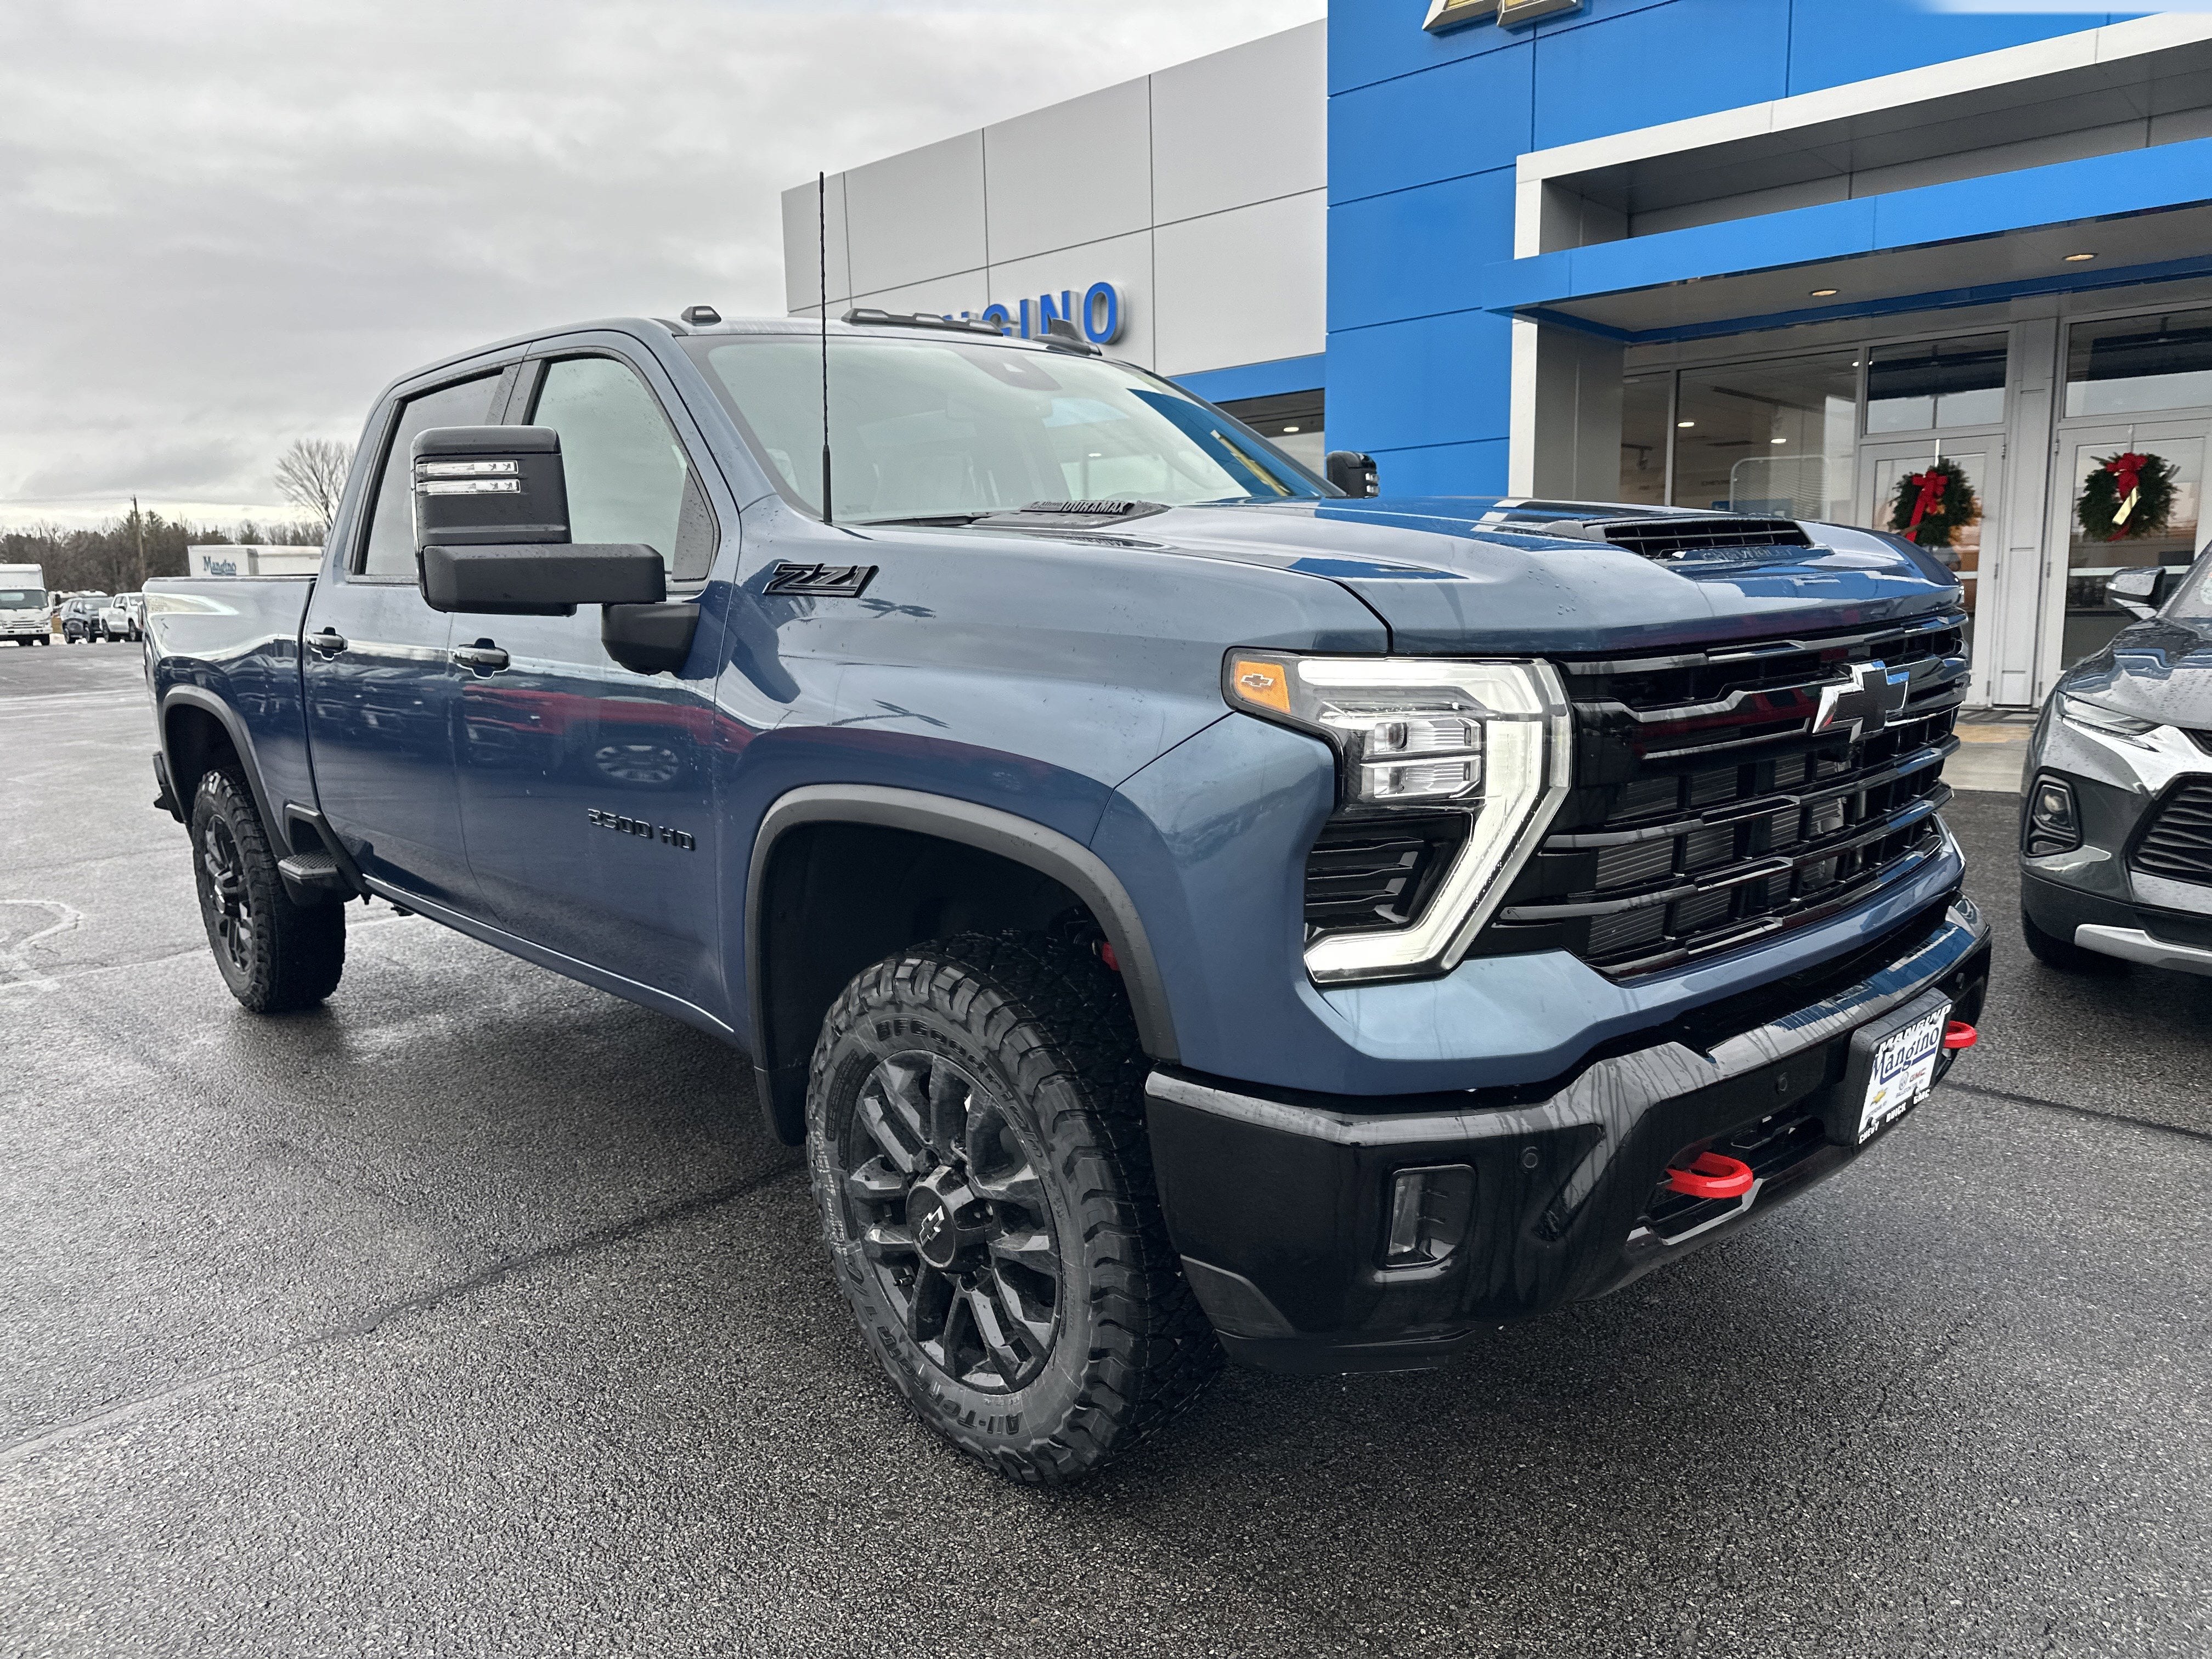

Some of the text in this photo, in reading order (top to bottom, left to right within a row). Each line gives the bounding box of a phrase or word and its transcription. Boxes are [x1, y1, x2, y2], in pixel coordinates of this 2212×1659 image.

[943, 281, 1118, 340] GINO
[1060, 500, 1130, 514] DURAMAX
[761, 562, 879, 598] Z71
[588, 808, 696, 851] 2500 HD
[1873, 1027, 1940, 1085] Mangino
[1858, 1121, 1880, 1144] CHEVY
[1886, 1102, 1906, 1123] BUICK
[1913, 1088, 1931, 1105] GMC
